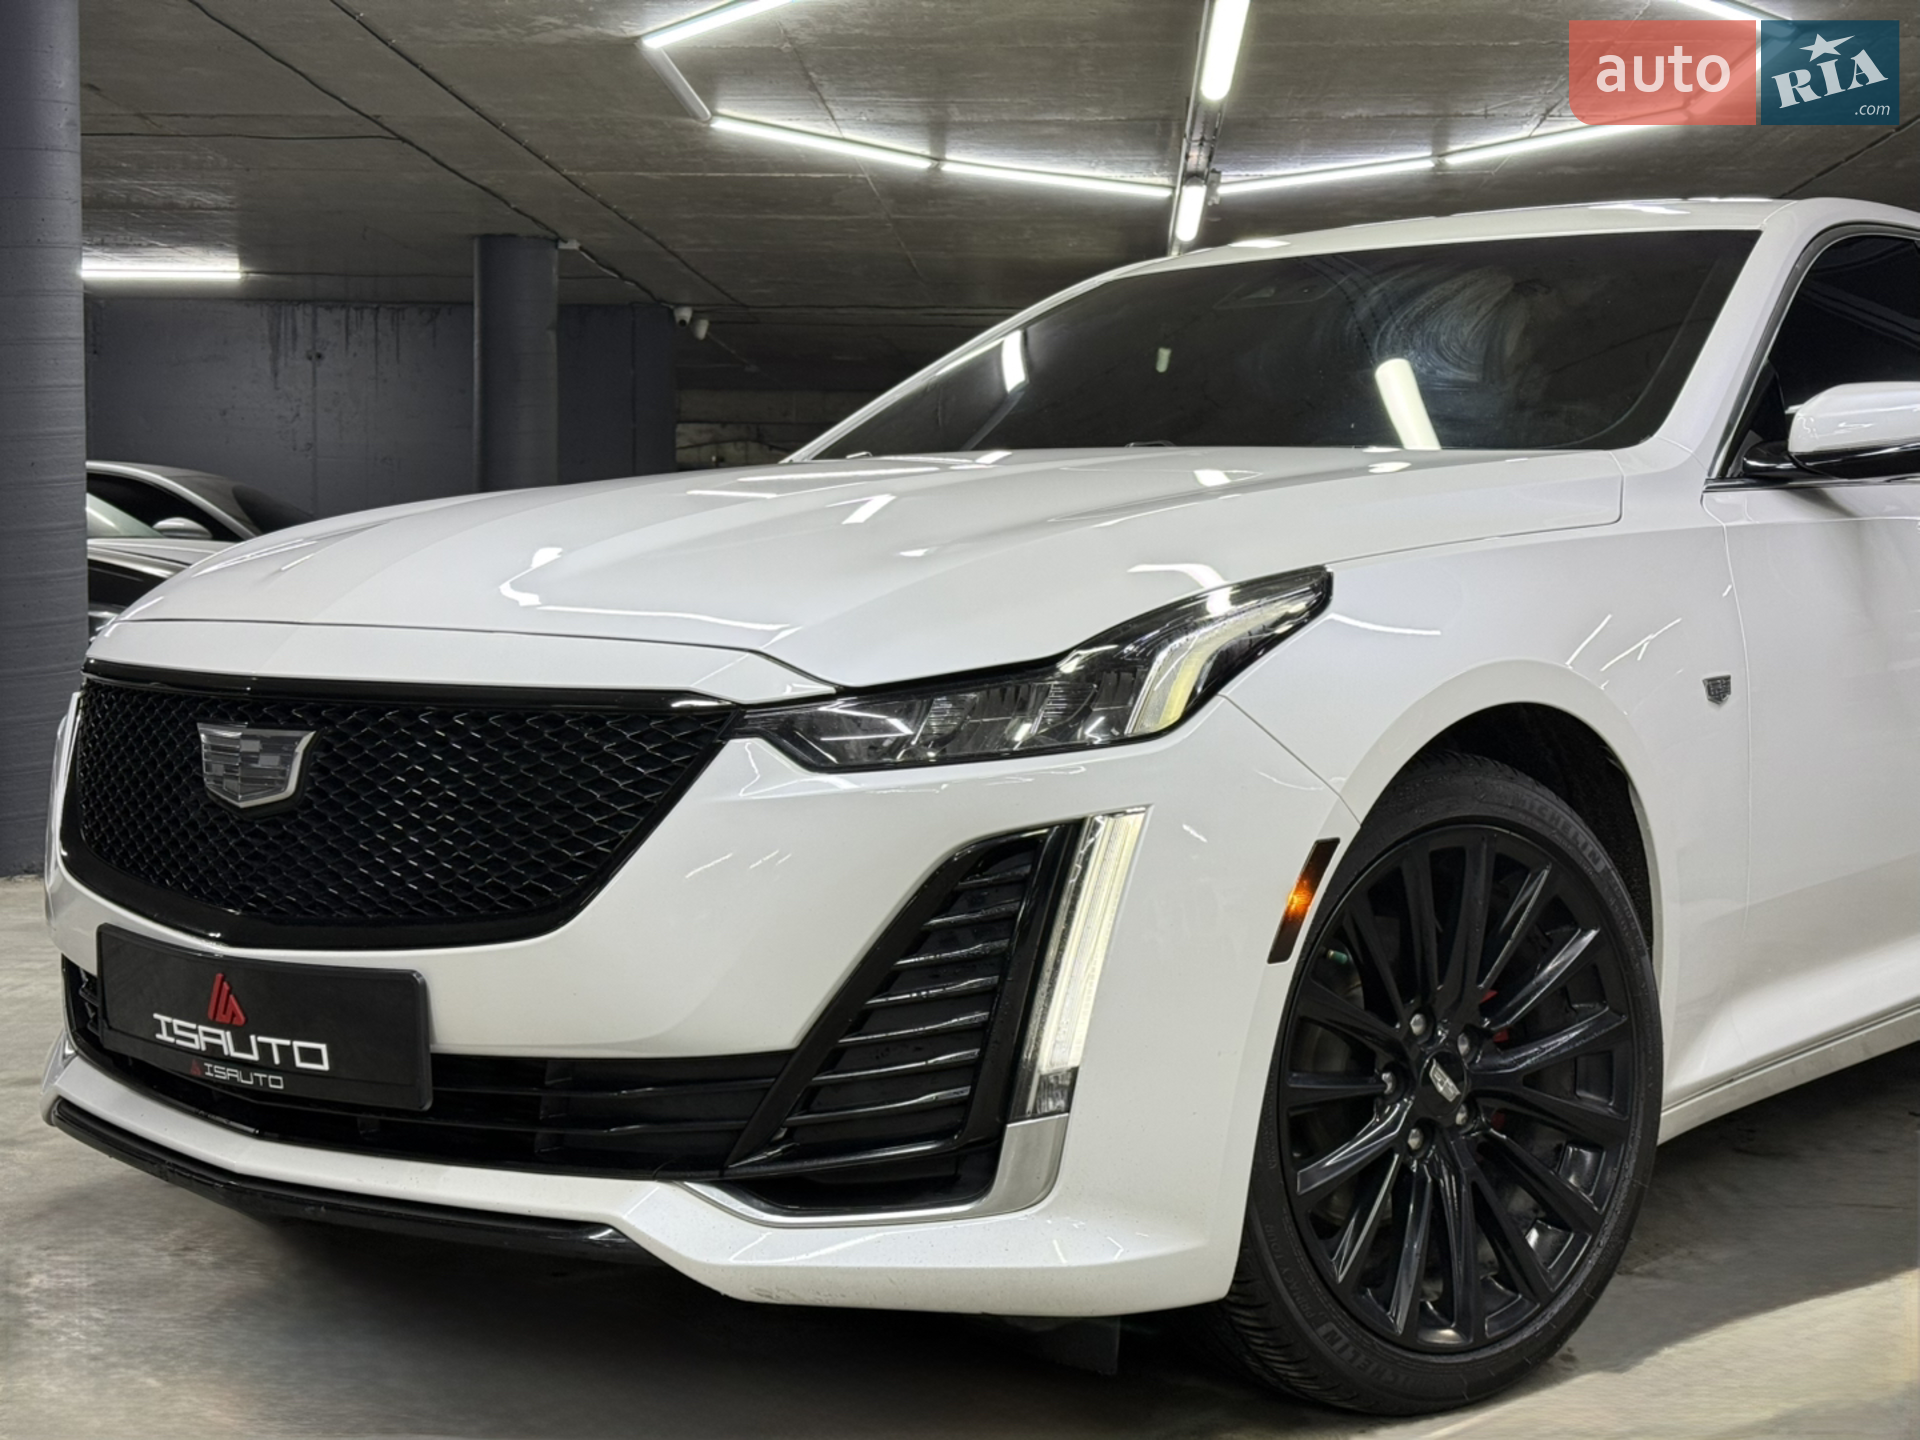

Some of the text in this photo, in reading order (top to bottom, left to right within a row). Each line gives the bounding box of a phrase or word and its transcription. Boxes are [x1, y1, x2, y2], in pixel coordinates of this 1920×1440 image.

[153, 1013, 330, 1071] ISAUTO
[204, 1062, 284, 1089] ISAUTO
[1263, 1223, 1314, 1319] PRIMACY TOUR
